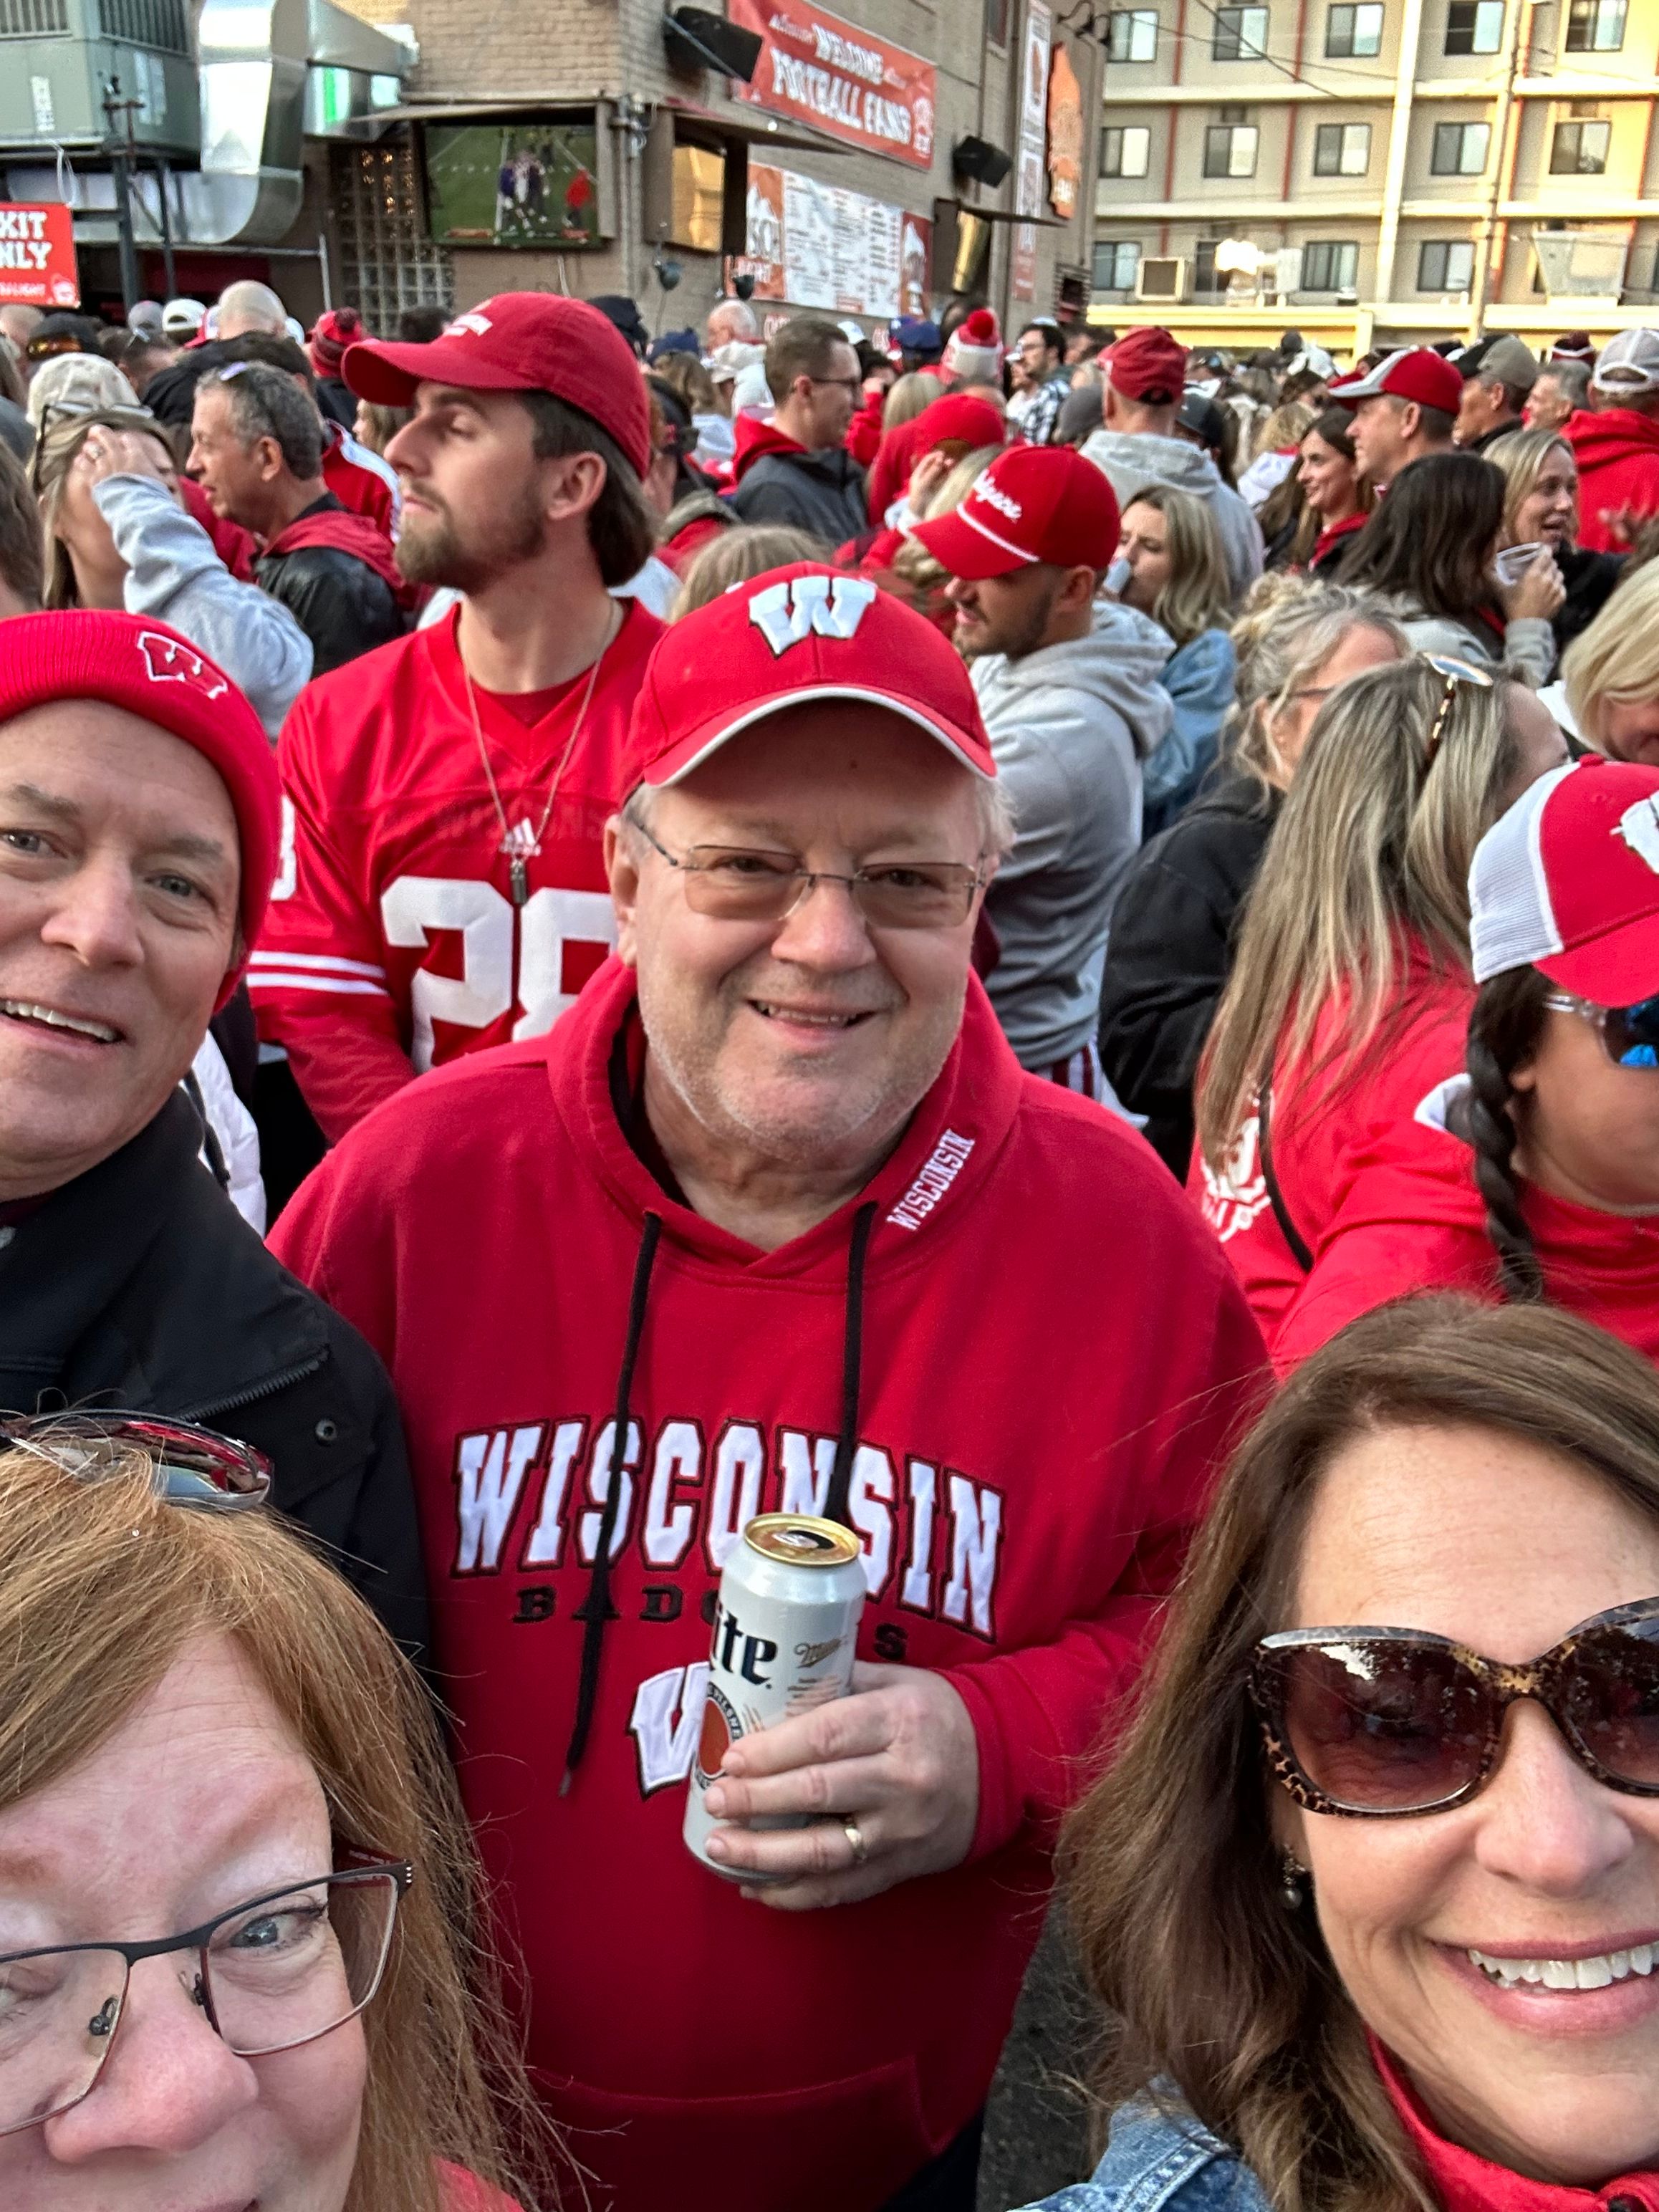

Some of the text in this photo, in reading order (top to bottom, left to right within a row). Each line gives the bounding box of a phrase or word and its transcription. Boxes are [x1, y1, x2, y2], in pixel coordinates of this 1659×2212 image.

[0, 210, 48, 240] XIT
[0, 240, 53, 271] NLY
[749, 575, 877, 660] W
[885, 1127, 976, 1232] WISCONSIN
[455, 1418, 1004, 1642] WISCONSIN
